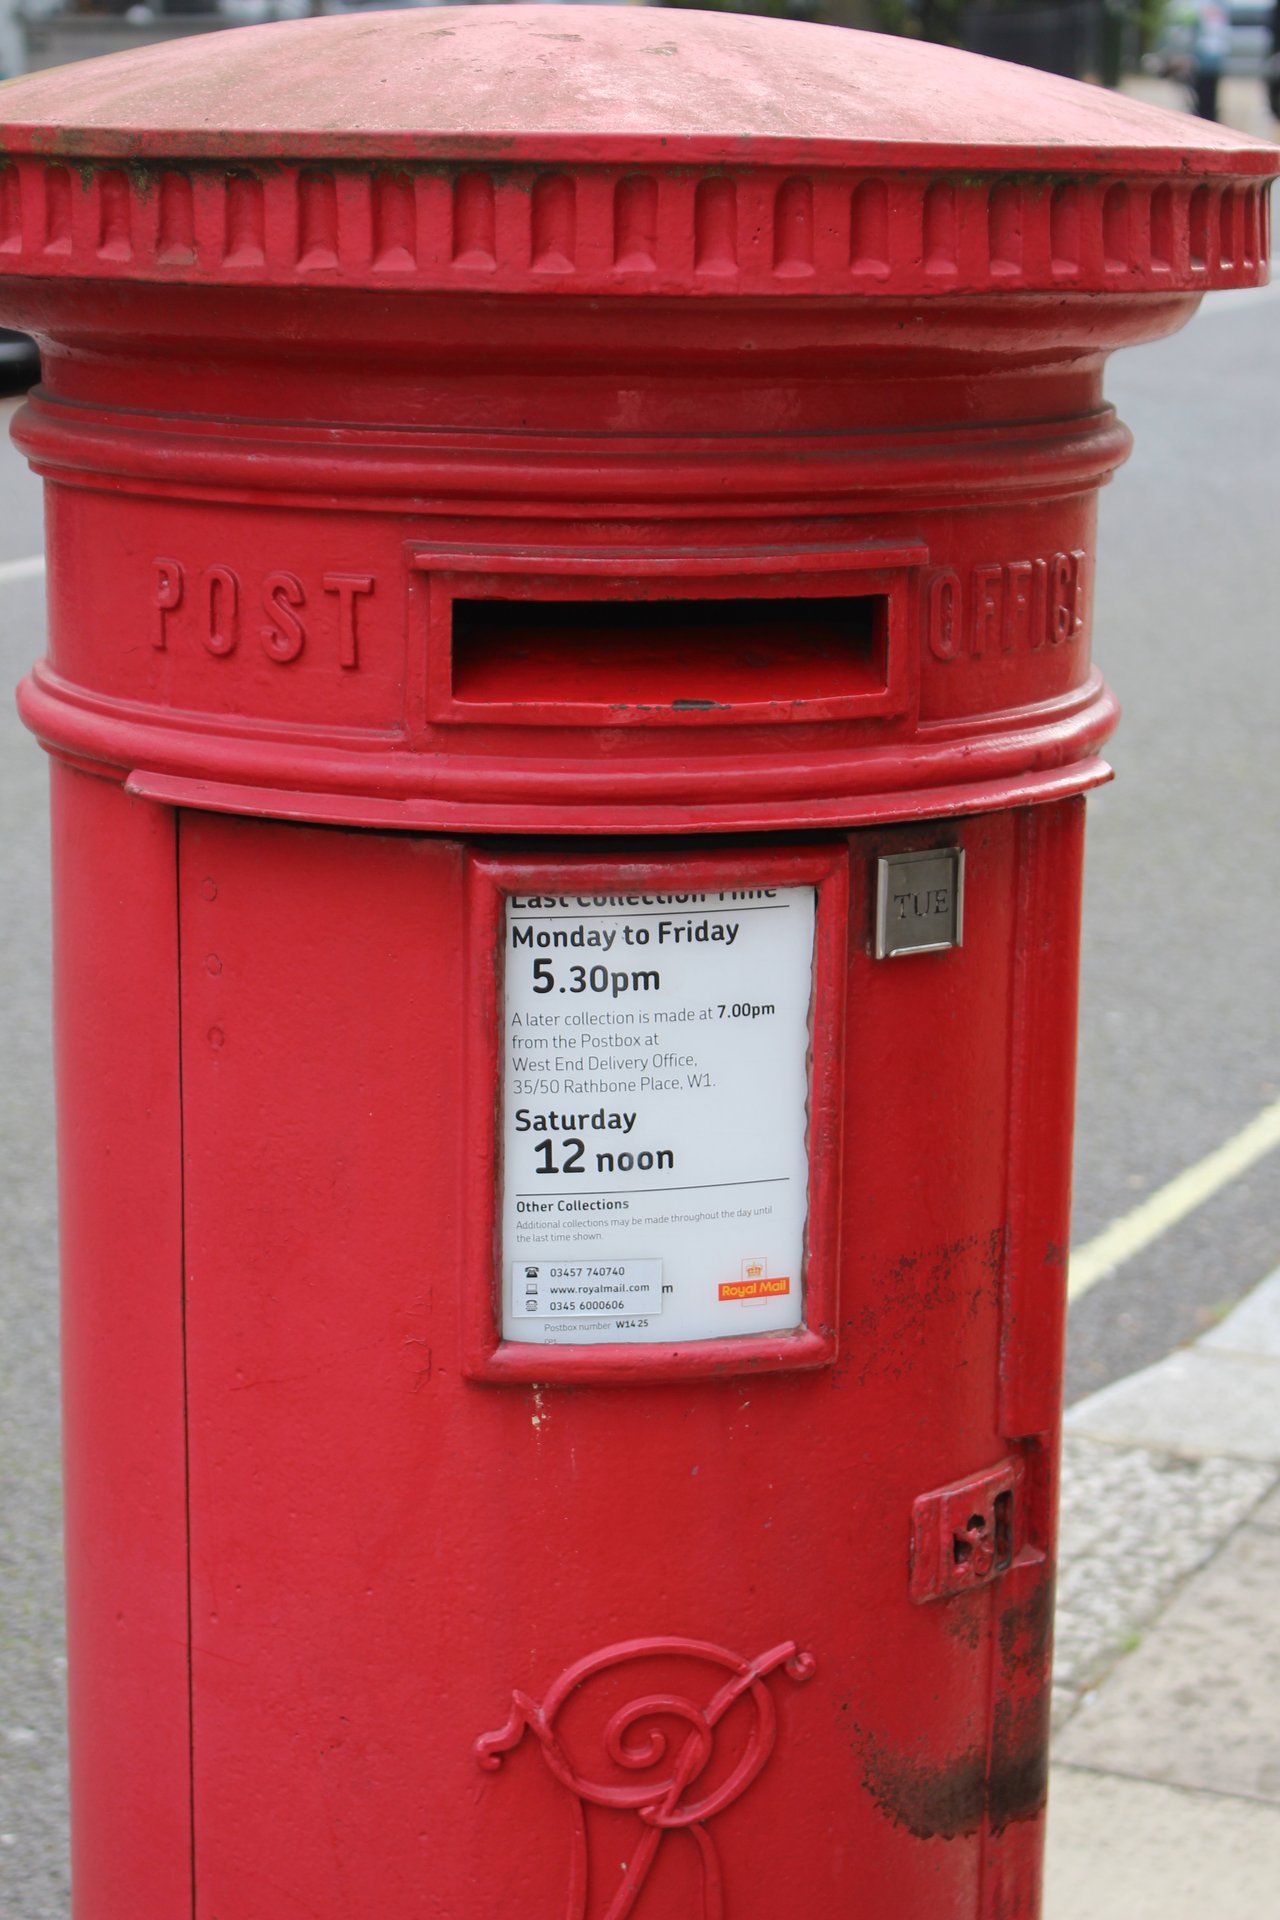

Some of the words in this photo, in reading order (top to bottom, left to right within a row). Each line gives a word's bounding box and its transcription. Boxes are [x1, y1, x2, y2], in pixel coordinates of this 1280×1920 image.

[152, 557, 375, 669] POST
[929, 550, 1085, 661] OFFICE
[893, 888, 949, 920] TUE
[512, 925, 616, 951] Monday
[623, 926, 649, 945] to
[659, 920, 739, 945] Friday
[533, 958, 659, 998] 5.30pm
[512, 1013, 522, 1026] A
[526, 1013, 560, 1026] later
[565, 1012, 634, 1025] collection
[639, 1010, 649, 1023] is
[654, 1008, 695, 1022] made
[699, 1008, 712, 1020] at
[718, 1003, 774, 1019] 7.00pm
[512, 1035, 548, 1049] from
[553, 1035, 576, 1048] the
[582, 1033, 640, 1048] Postbox
[645, 1033, 659, 1045] at
[512, 1057, 550, 1071] West
[556, 1057, 583, 1071] End
[589, 1056, 648, 1071] Delivery
[653, 1053, 697, 1068] Office,
[512, 1079, 559, 1094] 35/50
[564, 1079, 636, 1093] Rathbone
[641, 1077, 682, 1091] Place,
[687, 1073, 715, 1088] W1.
[516, 1108, 636, 1134] Saturday
[535, 1138, 585, 1174] 12
[596, 1150, 673, 1172] noon
[517, 1201, 553, 1212] Other
[558, 1199, 629, 1211] Collections
[516, 1220, 560, 1229] Additional
[563, 1219, 608, 1228] collections
[611, 1219, 629, 1227] may
[632, 1217, 642, 1225] be
[645, 1216, 669, 1224] made
[671, 1212, 719, 1222] throughout
[721, 1210, 735, 1218] the
[737, 1208, 752, 1218] day
[754, 1206, 772, 1215] until
[517, 1234, 531, 1242] the
[533, 1234, 548, 1242] last
[573, 1232, 603, 1240] shown.
[550, 1268, 582, 1277] 03457
[587, 1267, 624, 1276] 740740
[550, 1284, 649, 1295] www.royalmail.com
[722, 1283, 757, 1297] Royal
[760, 1279, 787, 1292] Mail
[550, 1302, 575, 1310] 0345
[580, 1301, 624, 1310] 6000606
[579, 1322, 611, 1330] number
